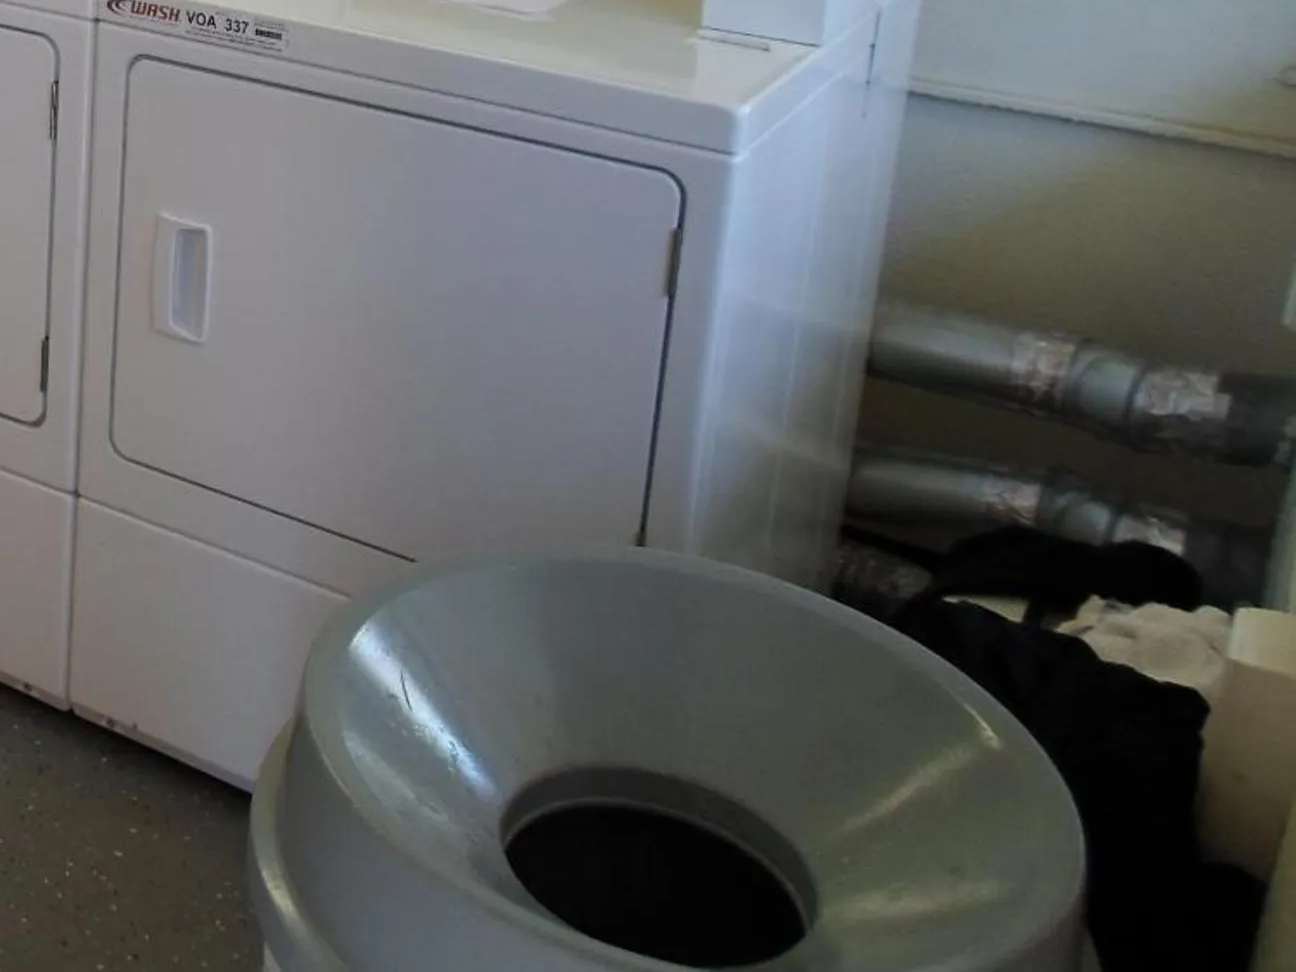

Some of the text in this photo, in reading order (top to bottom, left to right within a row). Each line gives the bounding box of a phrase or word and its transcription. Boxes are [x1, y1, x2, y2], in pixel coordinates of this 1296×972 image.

[130, 0, 250, 35] WASH VOA 337
